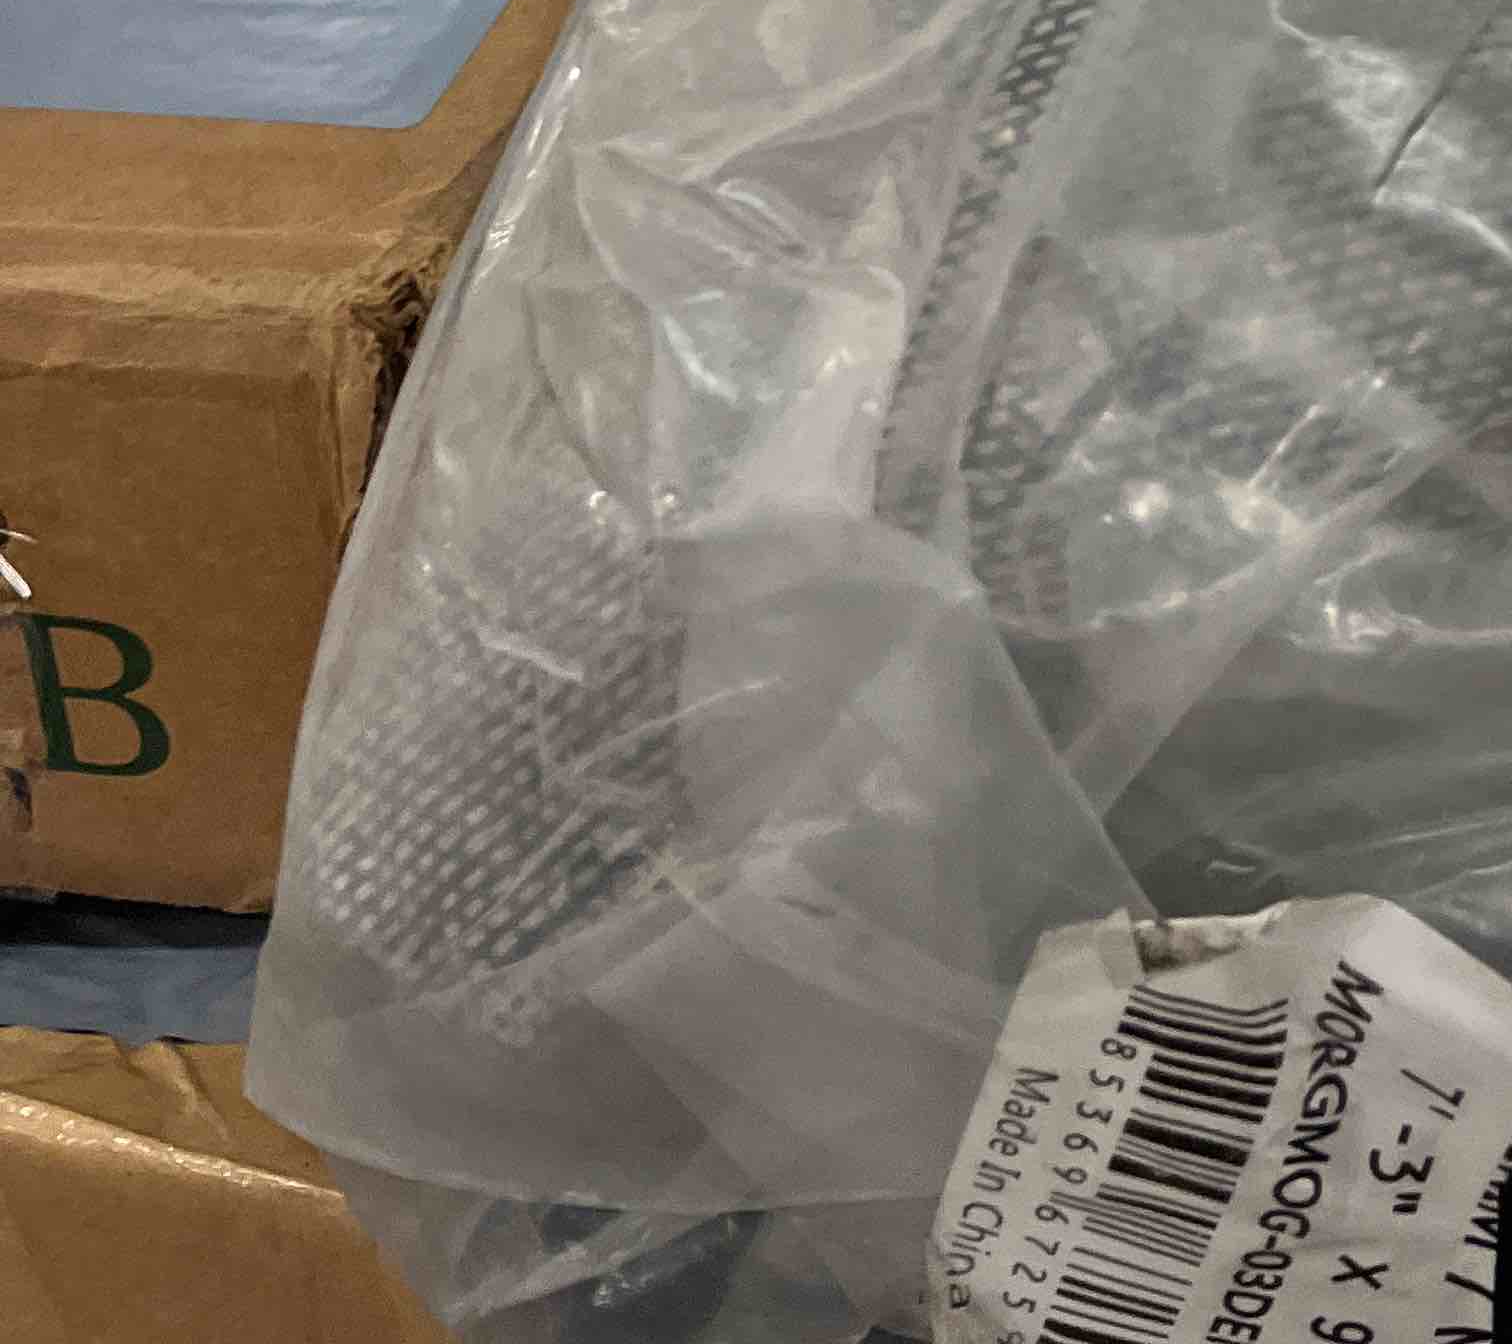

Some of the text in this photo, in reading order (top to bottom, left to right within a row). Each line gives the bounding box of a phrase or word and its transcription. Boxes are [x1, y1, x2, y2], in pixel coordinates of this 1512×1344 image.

[16, 612, 172, 777] B
[945, 1068, 1060, 1310] Made In China
[1205, 960, 1385, 1344] MORGMOG-03DE
